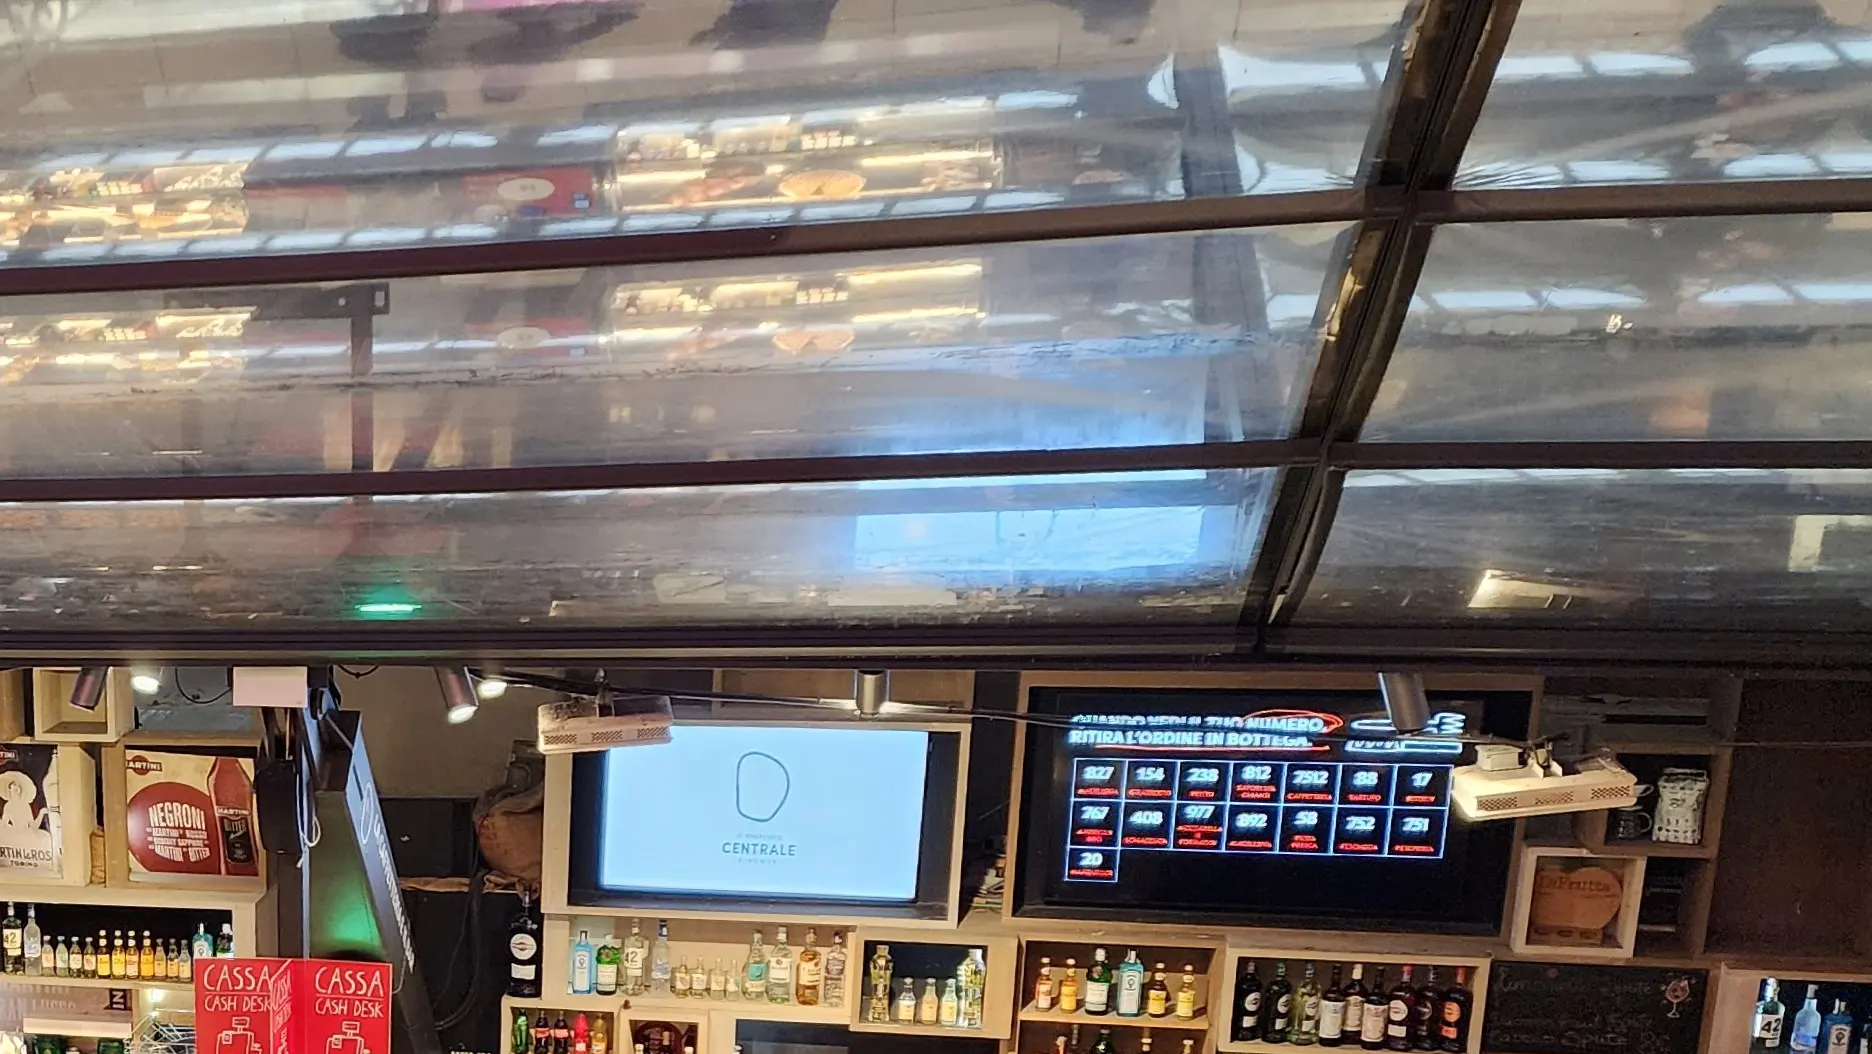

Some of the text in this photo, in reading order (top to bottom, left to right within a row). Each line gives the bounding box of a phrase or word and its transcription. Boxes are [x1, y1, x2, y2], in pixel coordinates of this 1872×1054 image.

[1068, 730, 1124, 744] RITIRA
[1125, 730, 1204, 745] L'ORDINE
[1205, 731, 1224, 745] IN
[1081, 765, 1115, 780] 827
[1241, 765, 1272, 780] 812
[1292, 769, 1329, 785] 7512
[1410, 772, 1433, 787] 17
[148, 802, 206, 831] NEGRONI
[722, 842, 797, 857] CENTRALE
[1079, 852, 1103, 867] 20
[203, 963, 271, 992] CASSA
[315, 966, 384, 998] CASSA
[204, 995, 272, 1013] CASH DESK
[315, 997, 384, 1019] CASH DESK
